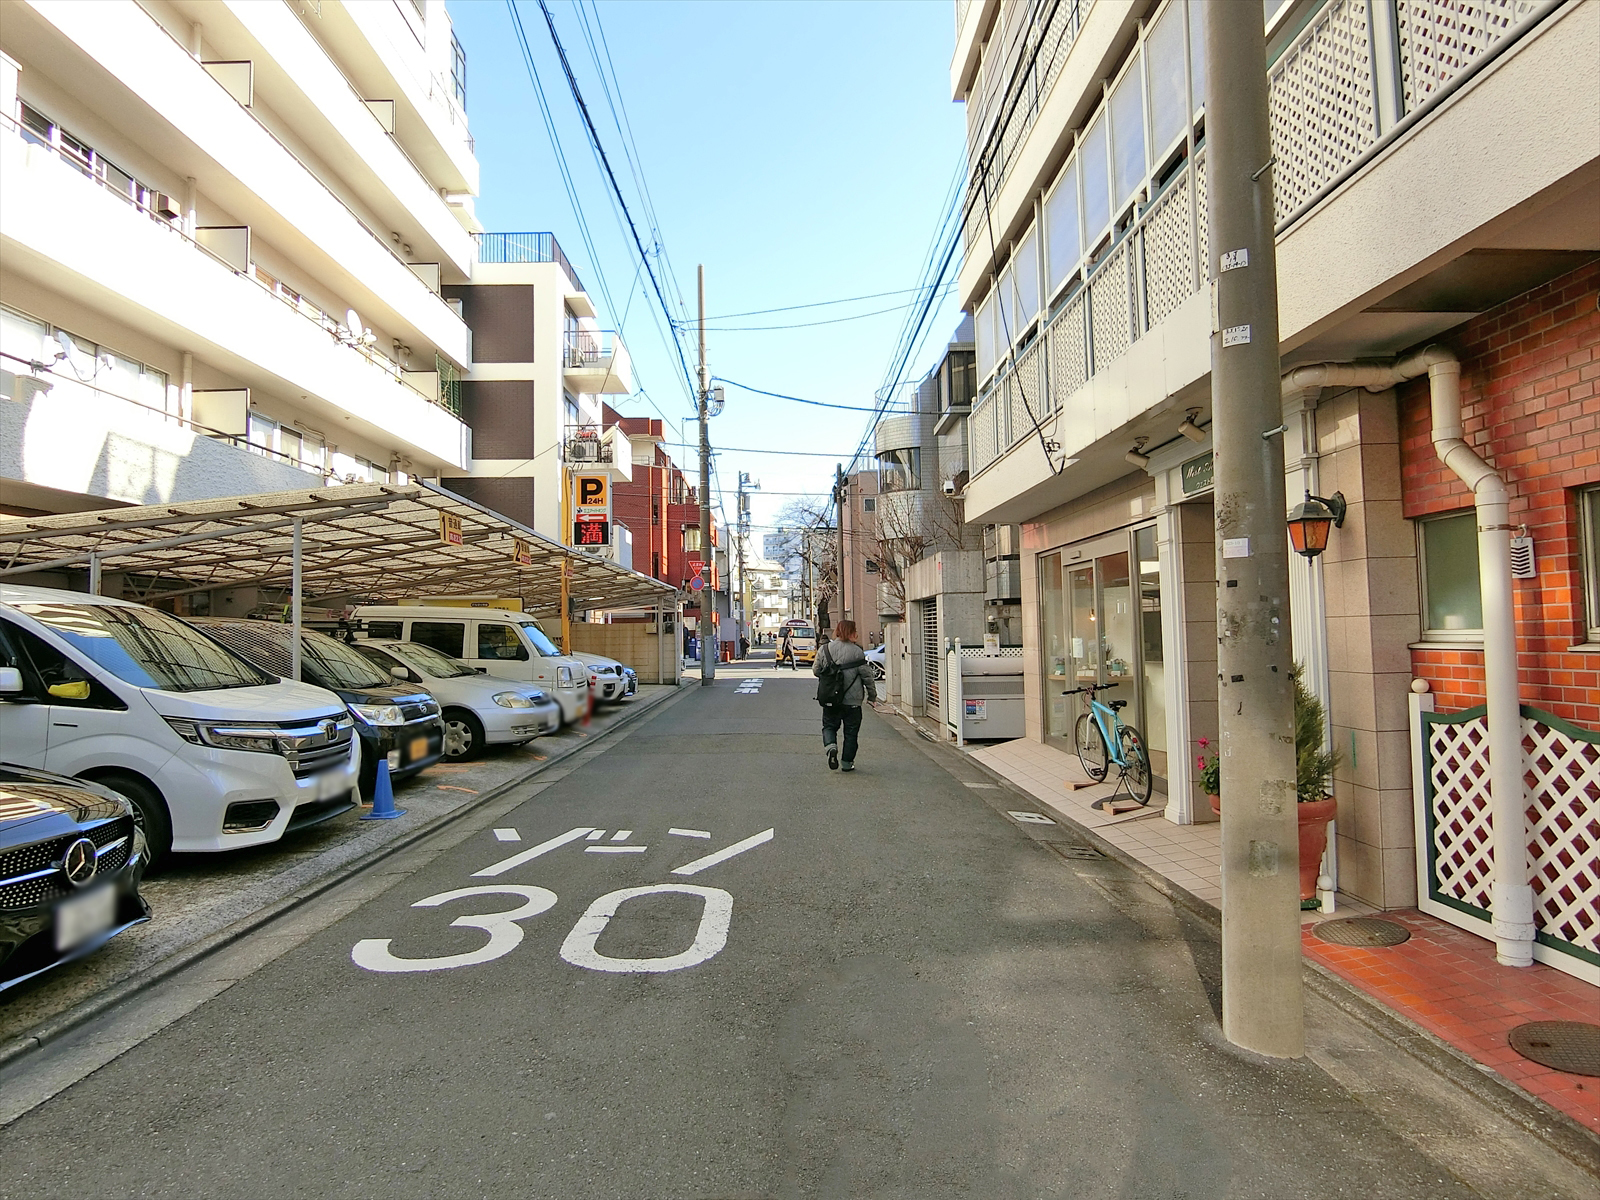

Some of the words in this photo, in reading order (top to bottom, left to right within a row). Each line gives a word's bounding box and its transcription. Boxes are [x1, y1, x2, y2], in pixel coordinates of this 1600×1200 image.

[581, 478, 603, 504] P
[442, 515, 446, 541] 1
[581, 523, 602, 544] 満
[515, 541, 520, 562] 2
[470, 828, 774, 877] ゾーン
[351, 883, 734, 973] 30
